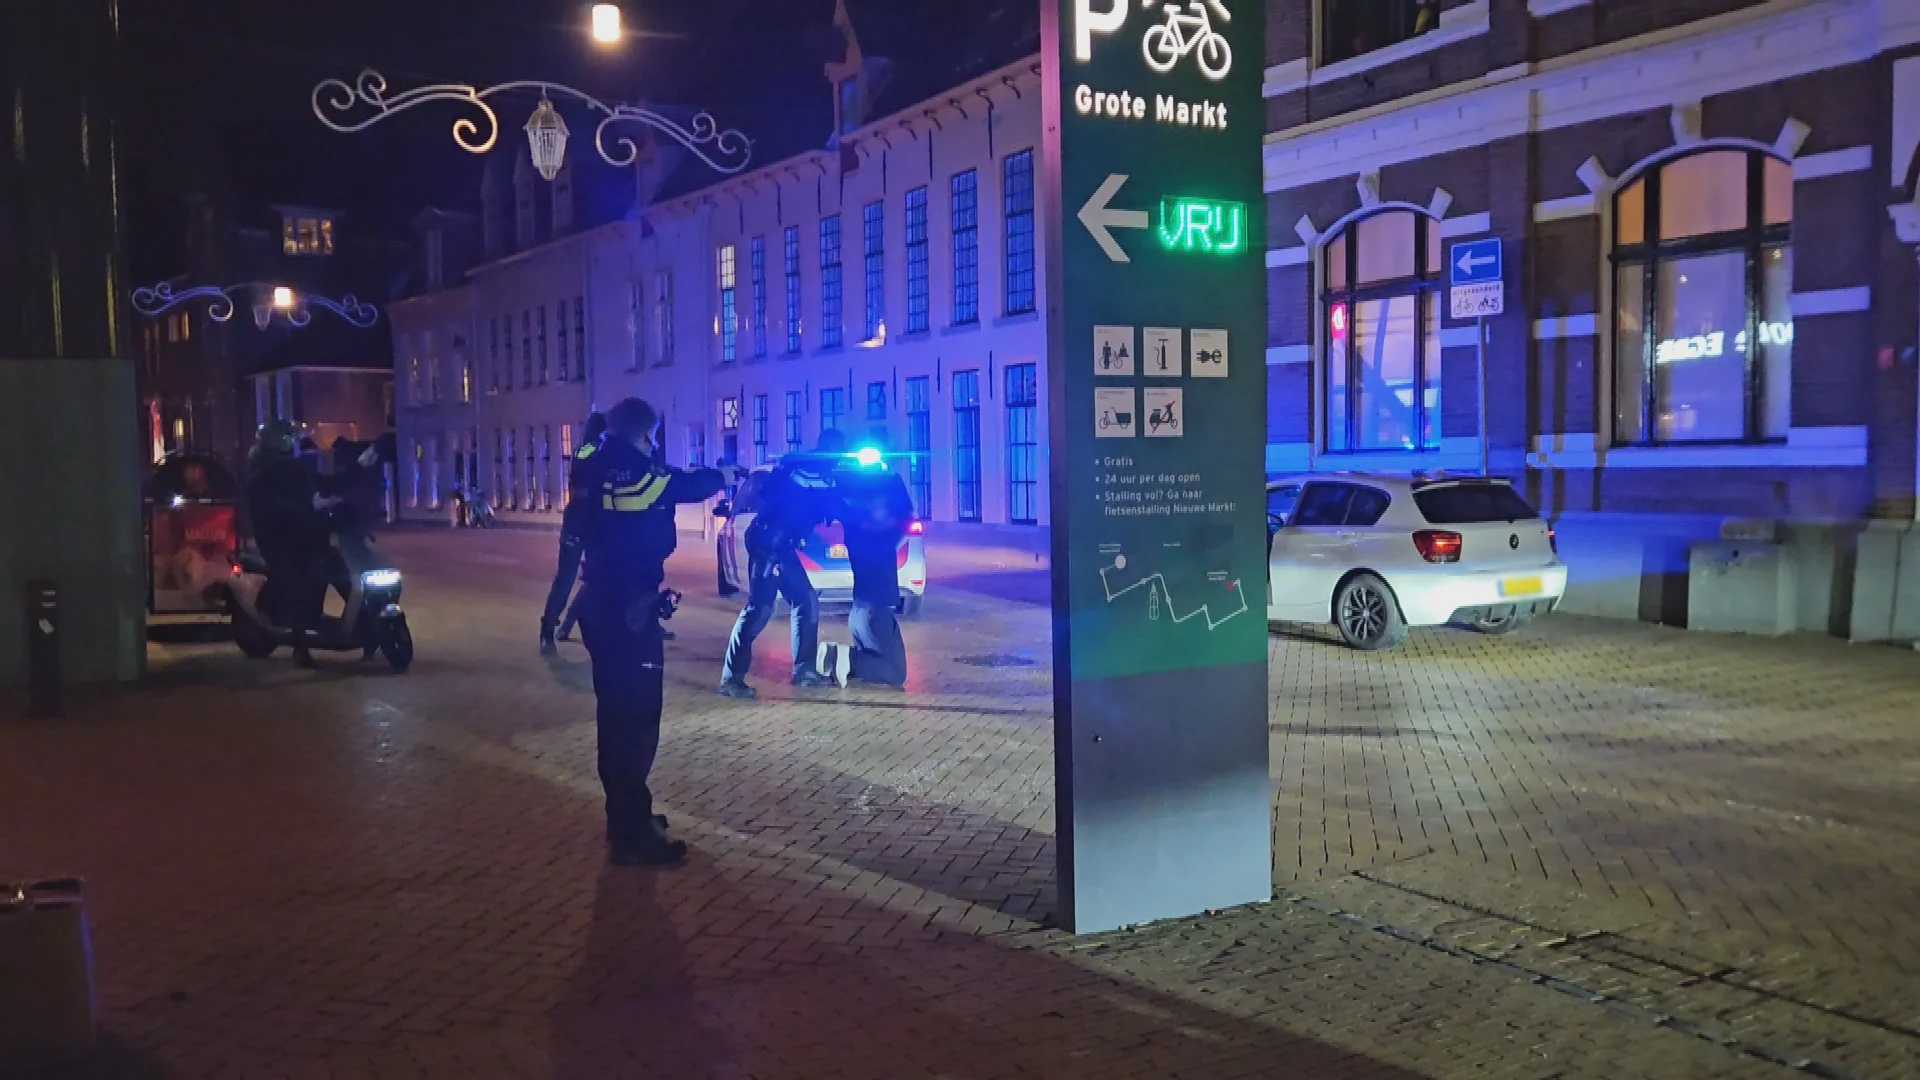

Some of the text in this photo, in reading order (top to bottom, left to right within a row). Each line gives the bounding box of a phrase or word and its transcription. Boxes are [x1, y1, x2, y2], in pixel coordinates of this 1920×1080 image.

[1074, 0, 1129, 62] P
[1075, 83, 1228, 130] Grote Markt
[1159, 200, 1240, 250] VRIJ
[1104, 456, 1134, 467] Gratis
[1104, 472, 1201, 485] 24 uur per dag open
[1104, 489, 1203, 502] Stalling vol? Ga naar
[1104, 504, 1171, 516] fietsenstalling
[1173, 503, 1206, 513] Nieuwe
